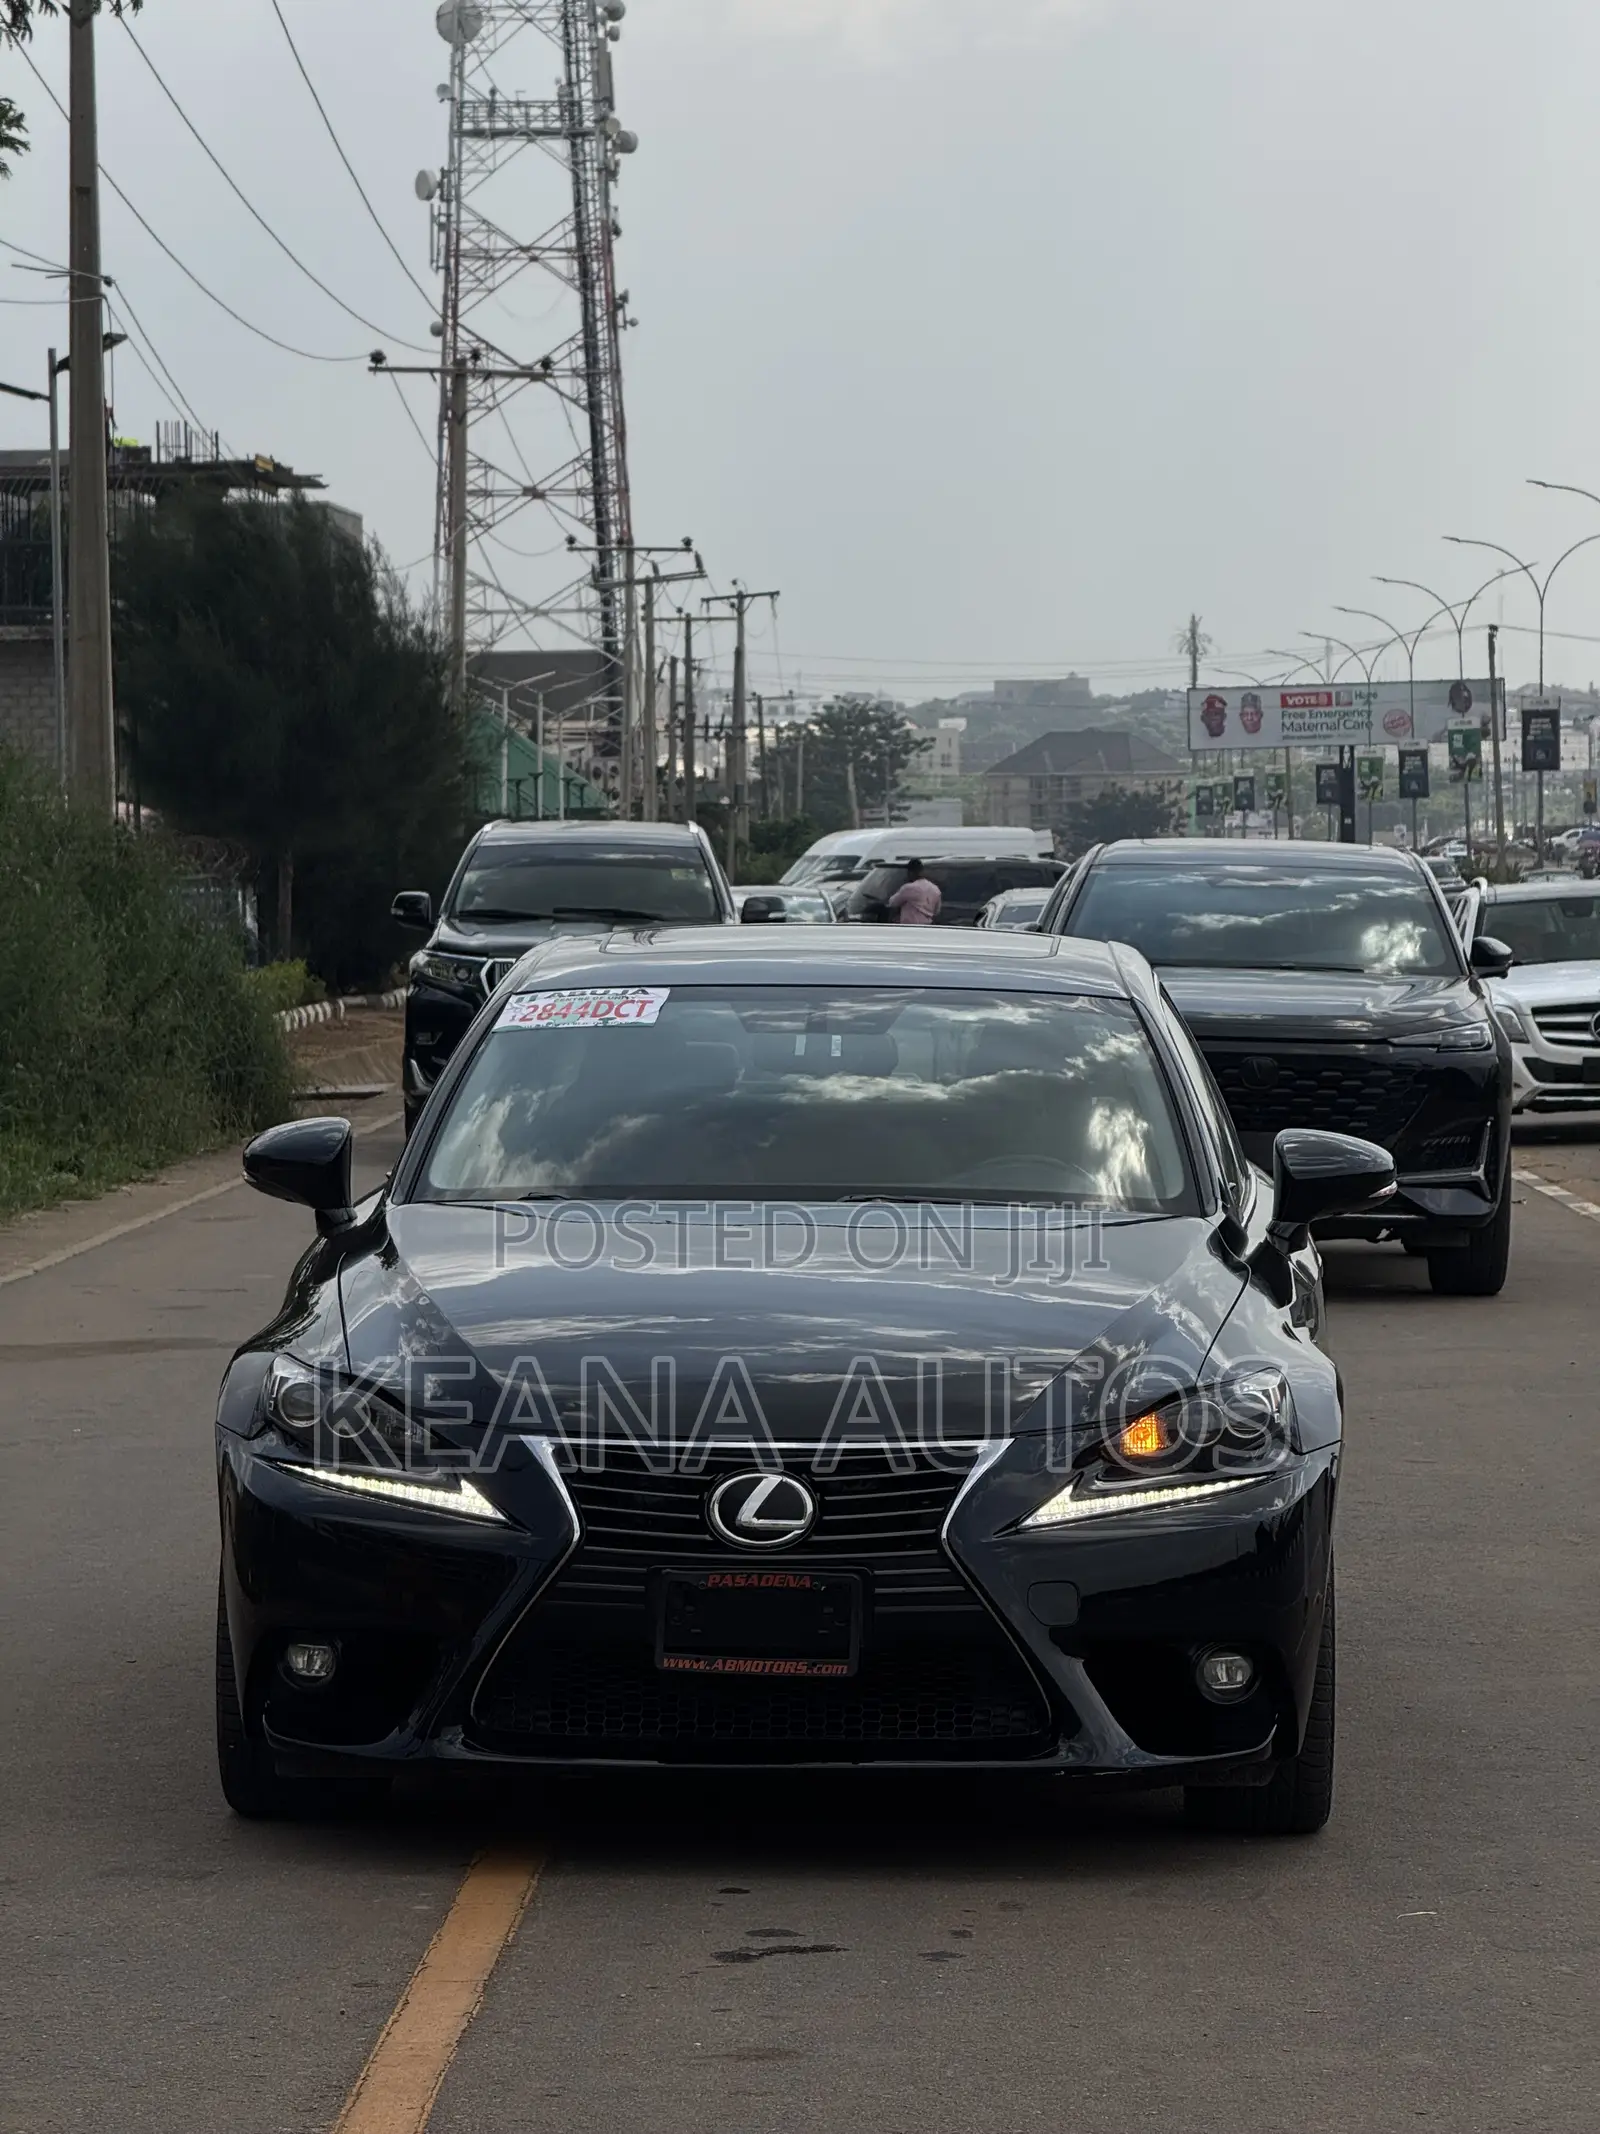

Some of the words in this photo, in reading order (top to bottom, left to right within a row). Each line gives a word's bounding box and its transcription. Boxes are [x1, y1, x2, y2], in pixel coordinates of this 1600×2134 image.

[1286, 695, 1317, 706] VOTE
[1281, 710, 1306, 720] Free
[1308, 708, 1372, 720] Emergency
[1281, 719, 1340, 733] Maternal
[1343, 718, 1374, 731] Care
[518, 1000, 654, 1023] 2844DCT
[706, 1573, 812, 1589] PASADENA
